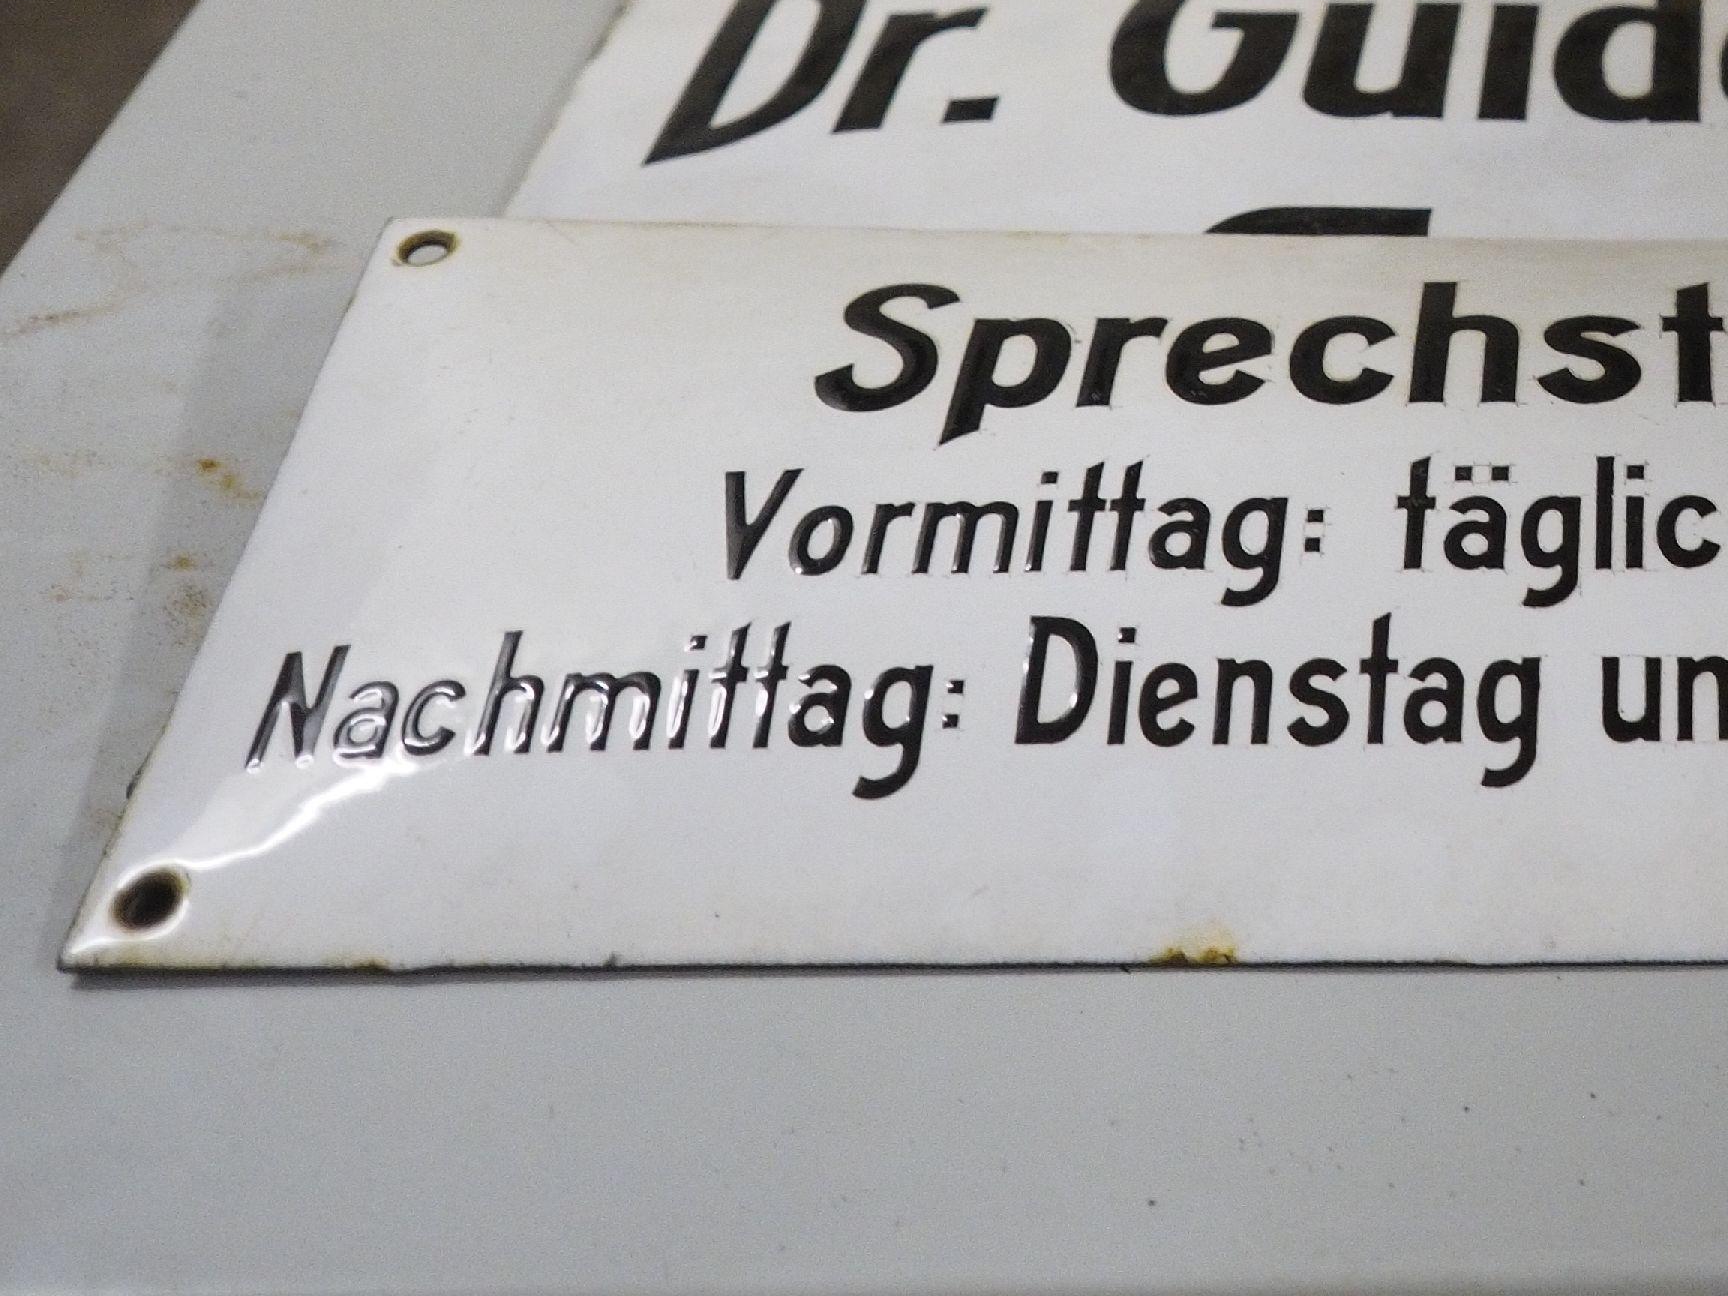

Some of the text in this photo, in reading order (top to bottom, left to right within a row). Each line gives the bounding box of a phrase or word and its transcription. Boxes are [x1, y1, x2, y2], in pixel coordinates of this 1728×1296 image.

[726, 461, 1324, 607] Vormittag:
[247, 623, 964, 800] Nachmittag:
[1015, 613, 1540, 788] Dienstag
